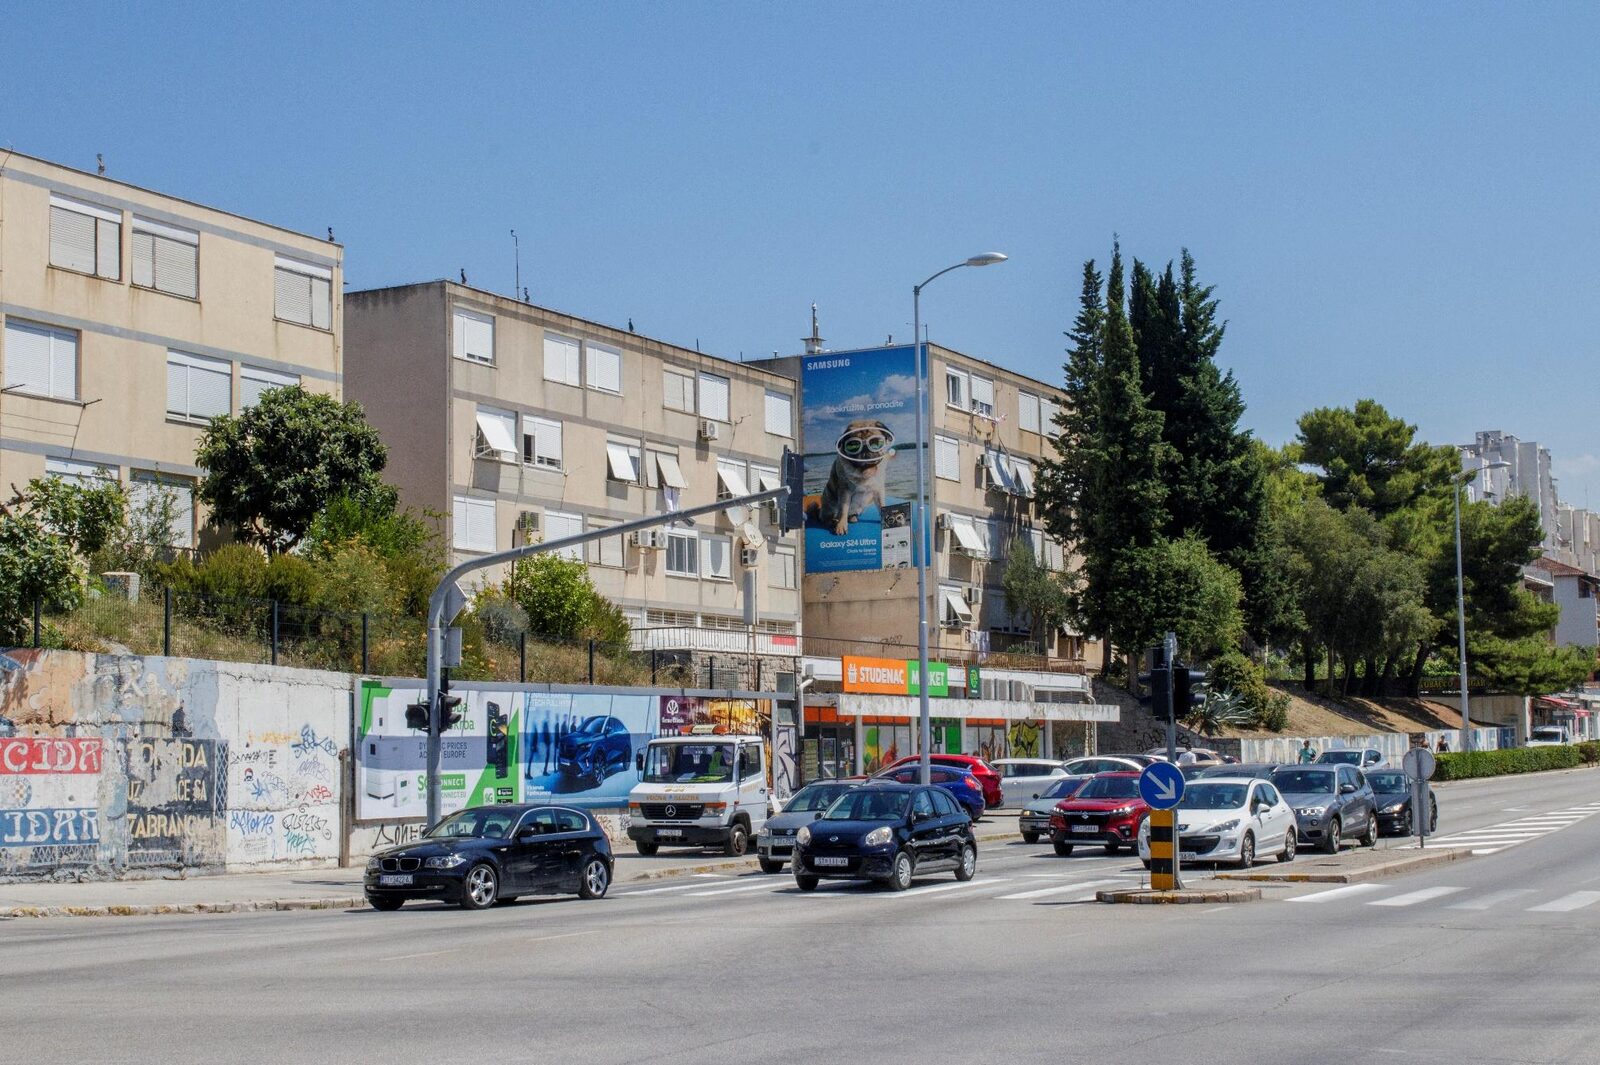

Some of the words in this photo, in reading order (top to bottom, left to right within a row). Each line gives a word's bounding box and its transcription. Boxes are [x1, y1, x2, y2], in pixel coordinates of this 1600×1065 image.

[807, 358, 851, 371] SAMSUNG
[820, 541, 846, 550] Galaxy
[846, 539, 859, 547] S24
[860, 538, 877, 546] Ultra
[860, 666, 905, 686] STUDENAC
[446, 741, 468, 750] PRICES
[0, 739, 101, 772] CIDA
[443, 750, 466, 759] EUROPE
